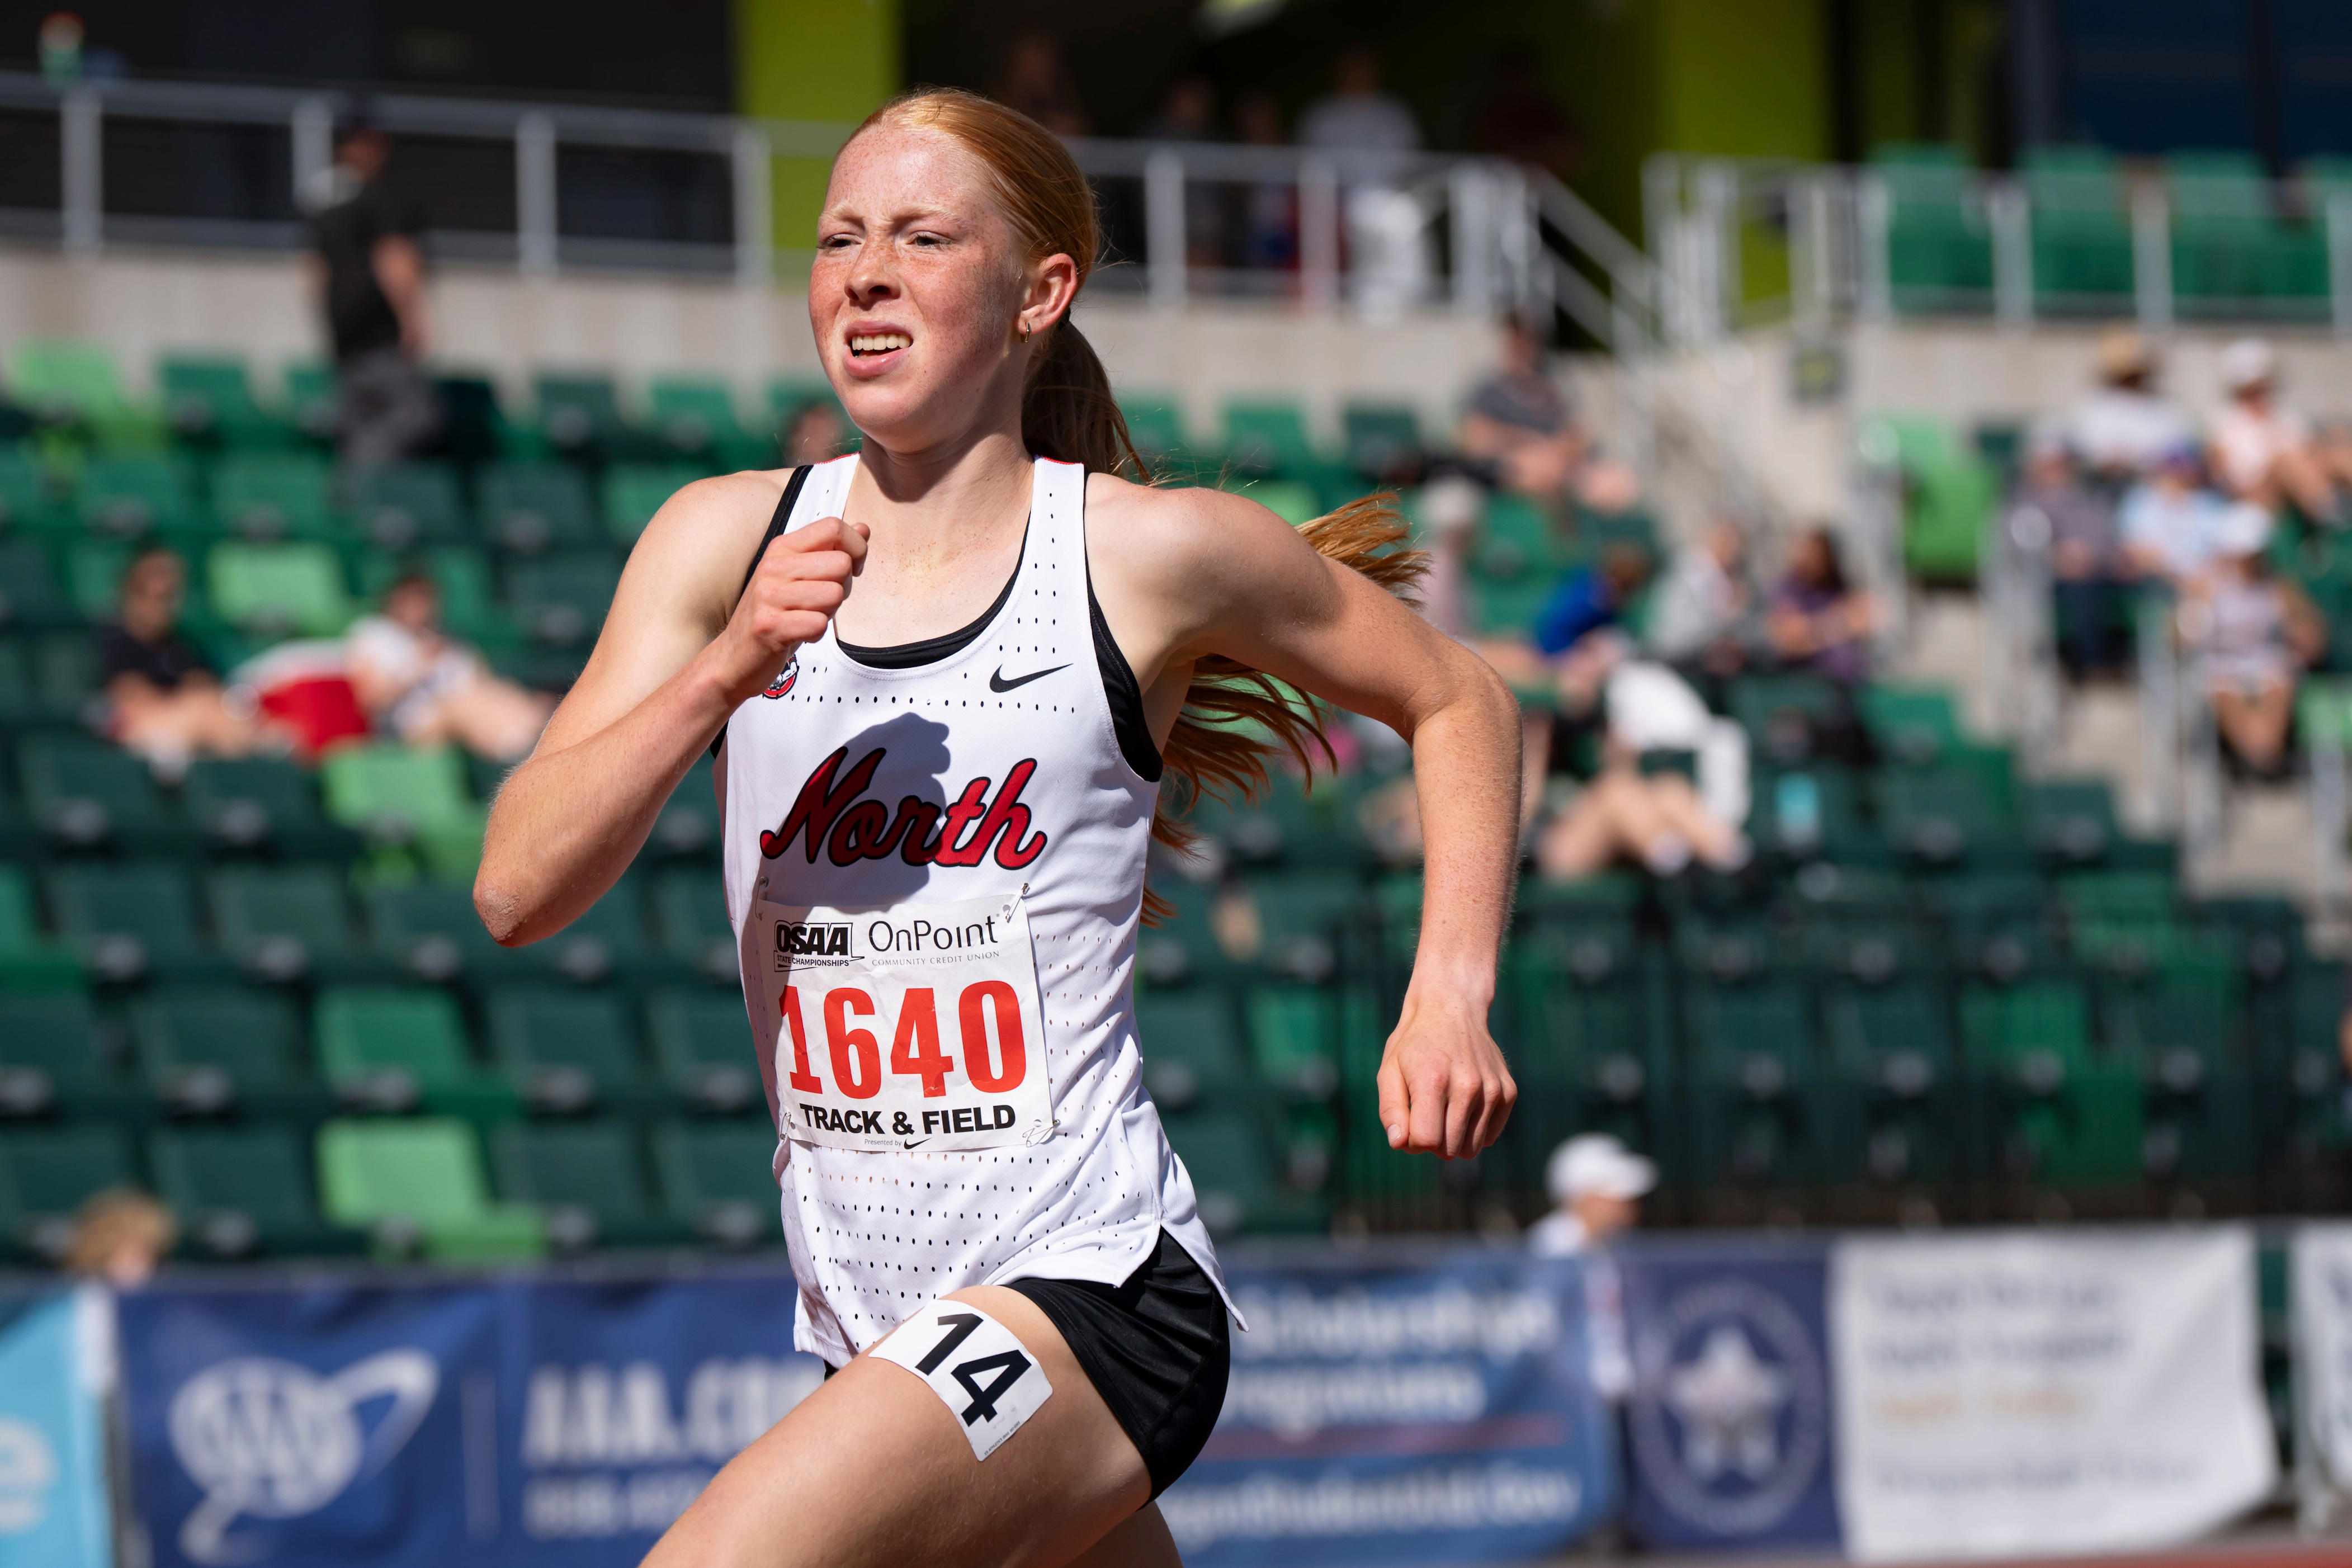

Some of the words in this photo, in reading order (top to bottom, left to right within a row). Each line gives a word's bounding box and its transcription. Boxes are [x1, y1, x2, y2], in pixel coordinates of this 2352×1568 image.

[759, 747, 1047, 870] North
[776, 923, 849, 956] OSAA
[868, 915, 998, 952] OnPoint
[777, 954, 791, 964] STATE
[792, 957, 849, 966] CHAMPIONSHIPS
[872, 957, 927, 966] COMMUNITY
[930, 955, 962, 964] CREDIT
[967, 951, 1000, 961] UNION
[778, 980, 1027, 1099] 1640
[799, 1103, 885, 1135] TRACK
[892, 1111, 915, 1135] &
[923, 1104, 1016, 1134] FIELD
[915, 1313, 1032, 1427] 14
